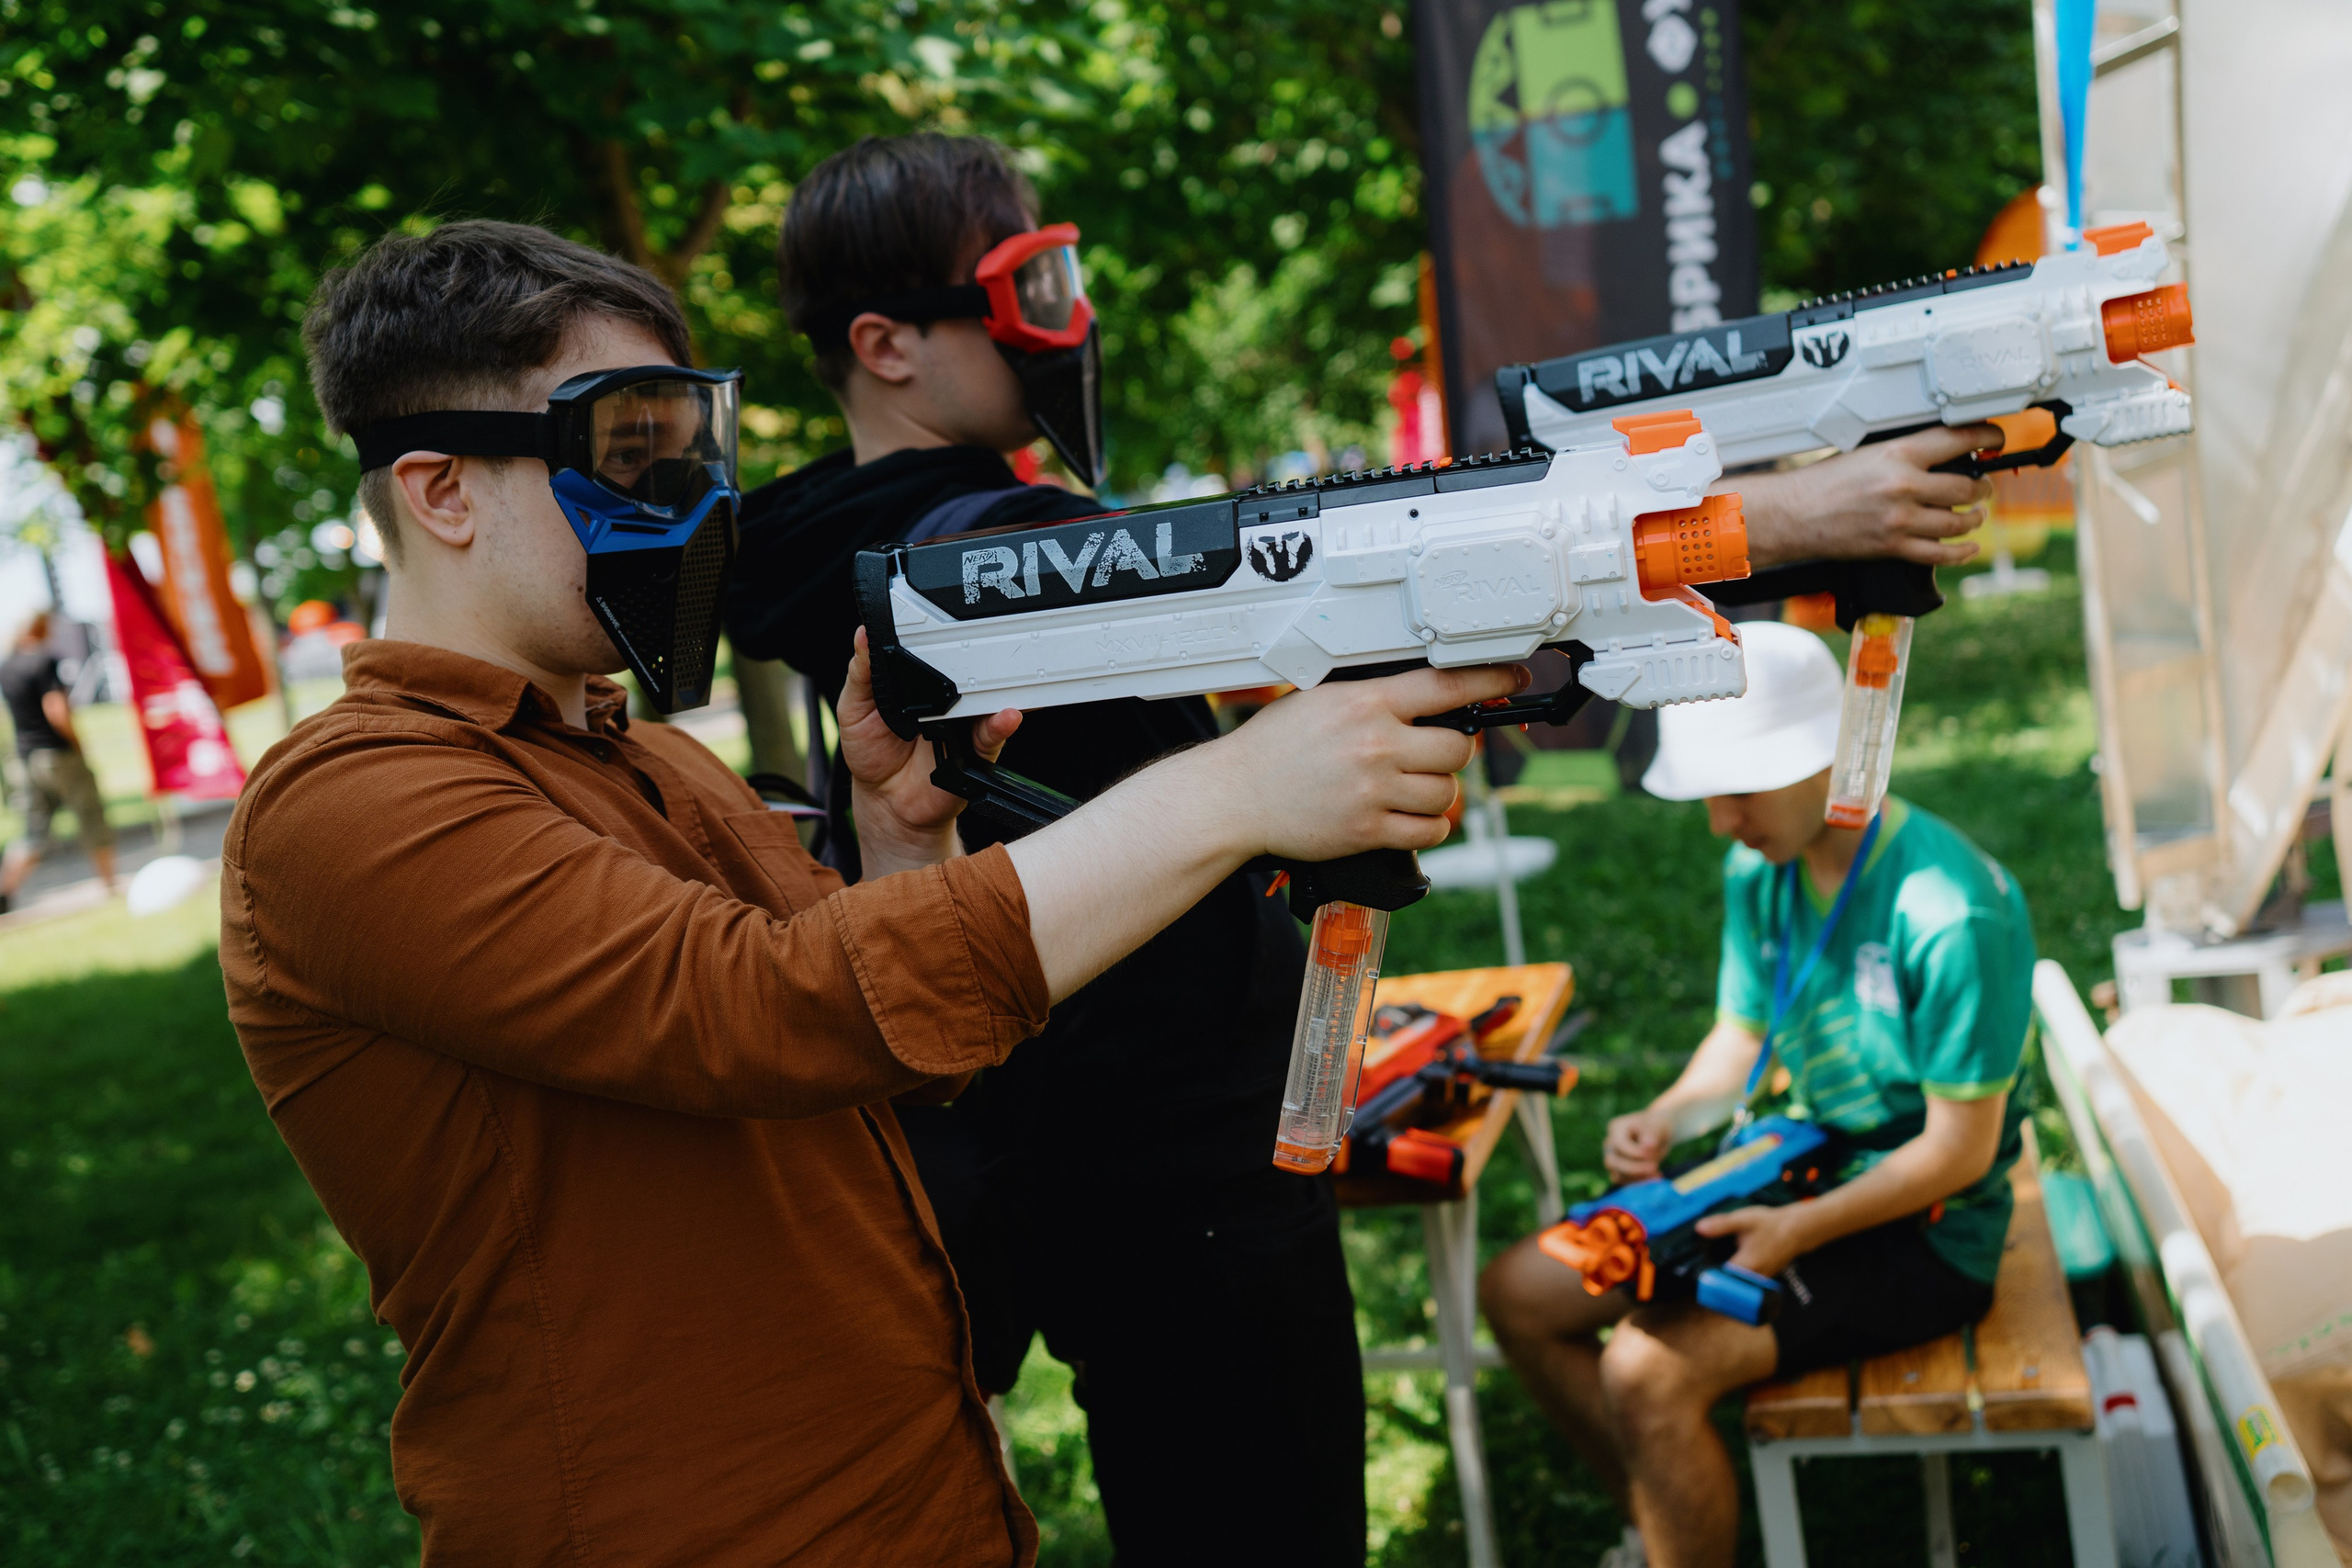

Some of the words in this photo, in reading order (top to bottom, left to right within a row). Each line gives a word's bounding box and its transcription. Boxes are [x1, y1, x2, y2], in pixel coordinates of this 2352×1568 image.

[1577, 330, 1768, 403] RIVAL
[962, 523, 1206, 604] RIVAL
[964, 550, 994, 566] NERF
[1452, 574, 1542, 604] RIVAL
